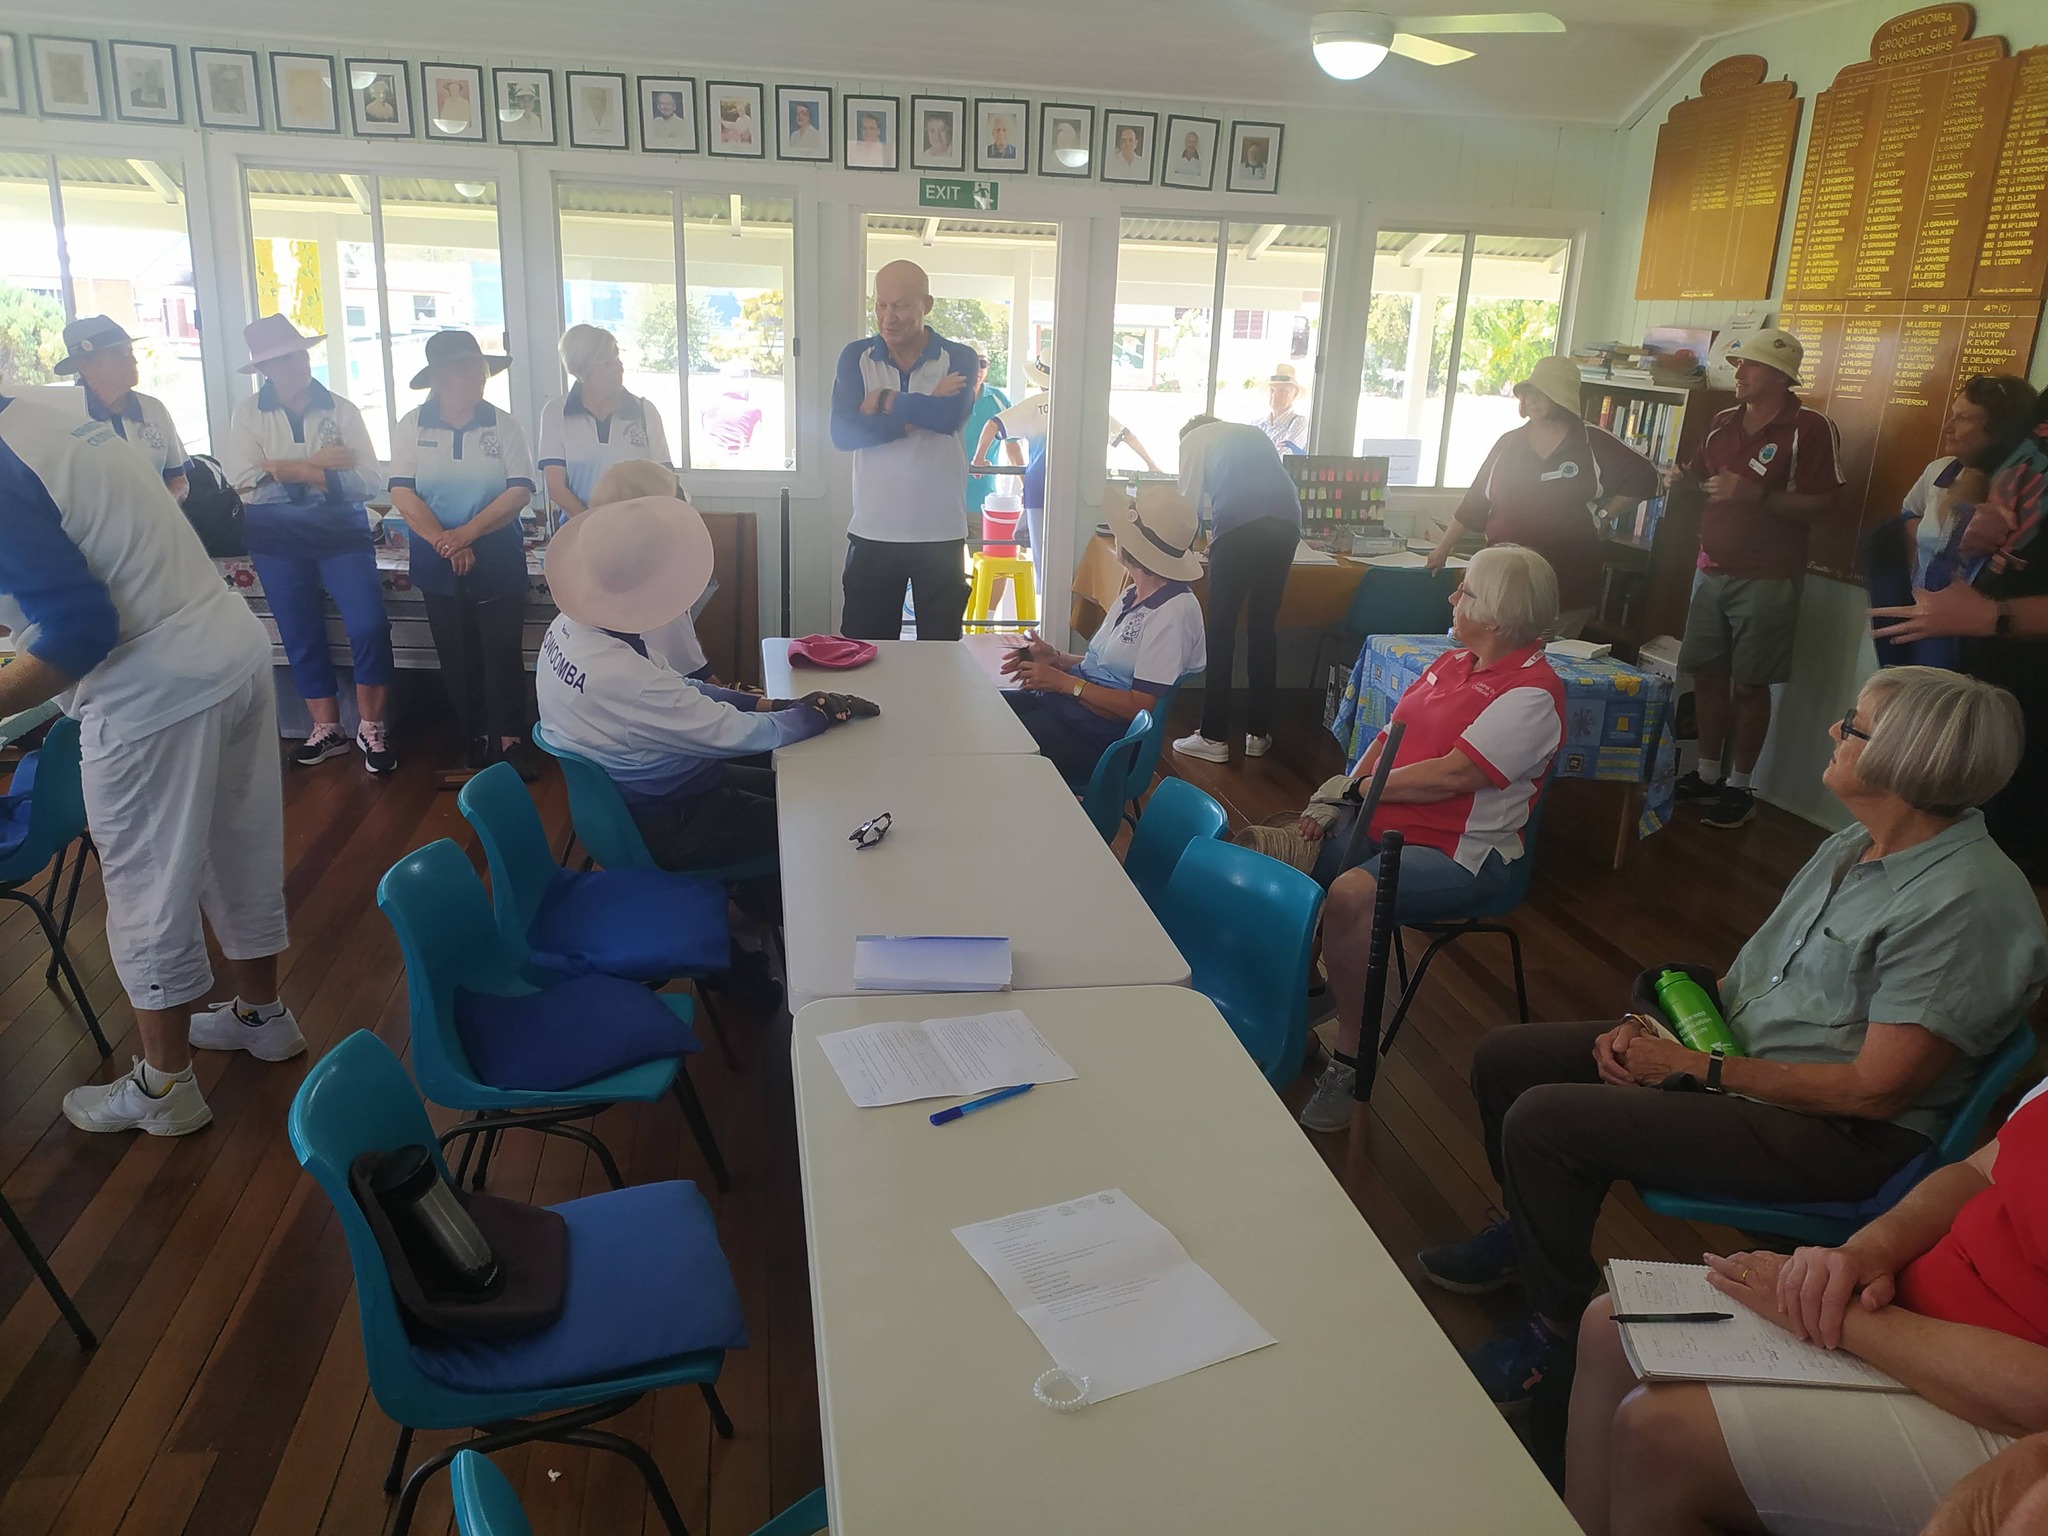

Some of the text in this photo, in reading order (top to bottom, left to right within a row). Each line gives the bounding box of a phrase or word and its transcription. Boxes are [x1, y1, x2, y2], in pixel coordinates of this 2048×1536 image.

[1889, 12, 1953, 35] TOOWOOMBA
[1879, 25, 1958, 51] CROQUET CLUB
[1878, 41, 1953, 66] CHAMPIONSHIPS
[1934, 164, 1963, 172] J.LEAHY
[1932, 171, 1975, 181] N.MORRISSY
[926, 184, 960, 200] EXIT
[1924, 220, 1959, 228] J.GRAHAM
[1938, 304, 1950, 313] (B)
[1999, 304, 2010, 314] (C)
[1970, 322, 2010, 330] J.HUGHES
[1964, 348, 2017, 356] M.MACDONALD
[1962, 357, 2007, 365] E.DELANEY
[1839, 368, 1872, 376] E.DELANEY
[1890, 398, 1928, 406] J.PATERSON
[544, 630, 586, 694] OWOOMBA
